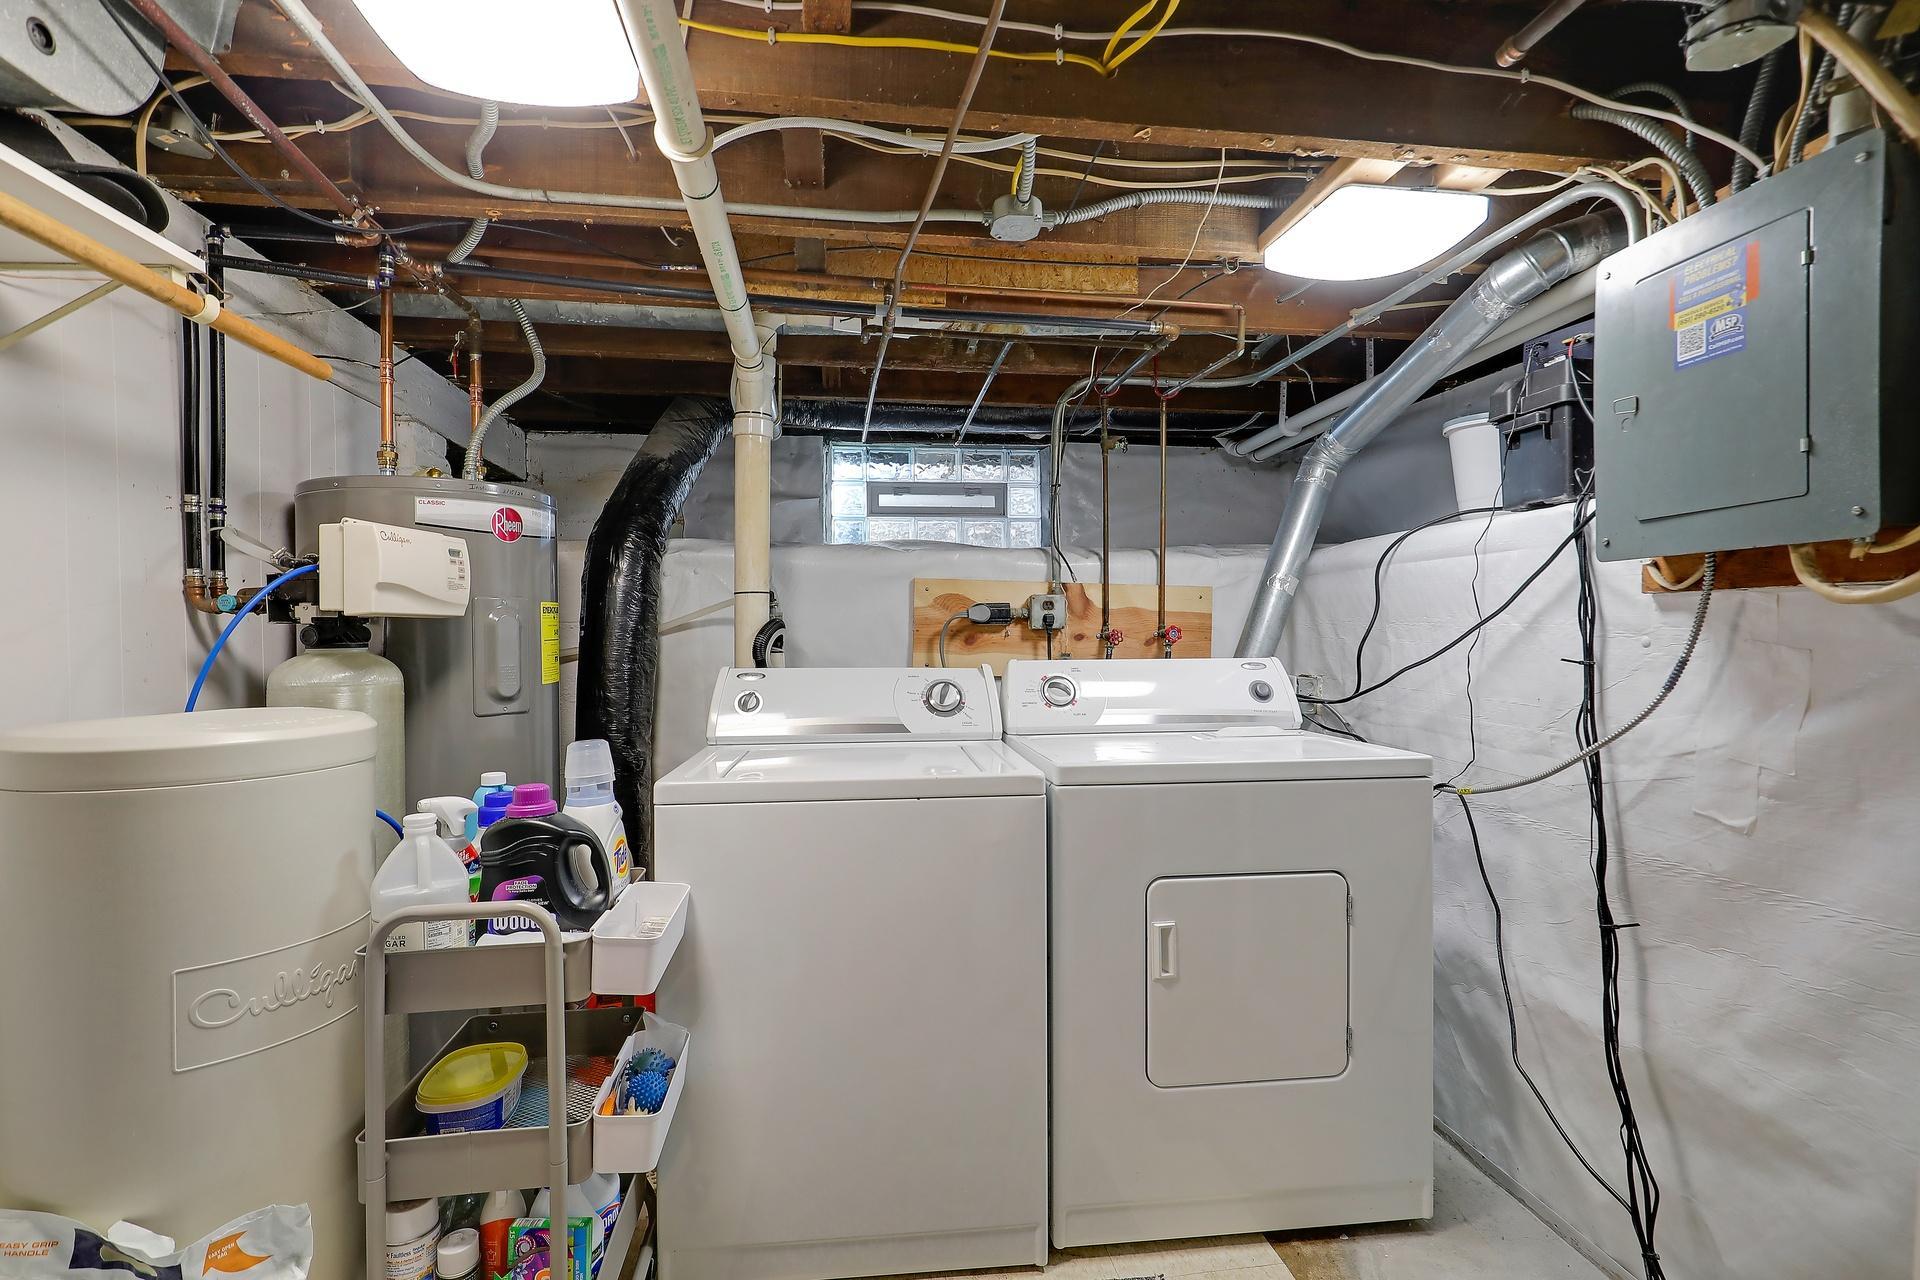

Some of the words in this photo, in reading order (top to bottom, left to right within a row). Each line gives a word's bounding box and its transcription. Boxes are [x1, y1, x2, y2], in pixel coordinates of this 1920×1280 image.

[1715, 317, 1738, 332] MSP
[418, 499, 446, 507] CLASSIC
[494, 507, 523, 538] Rheem
[31, 1240, 59, 1249] GRIP
[3, 1249, 49, 1257] HANDLE
